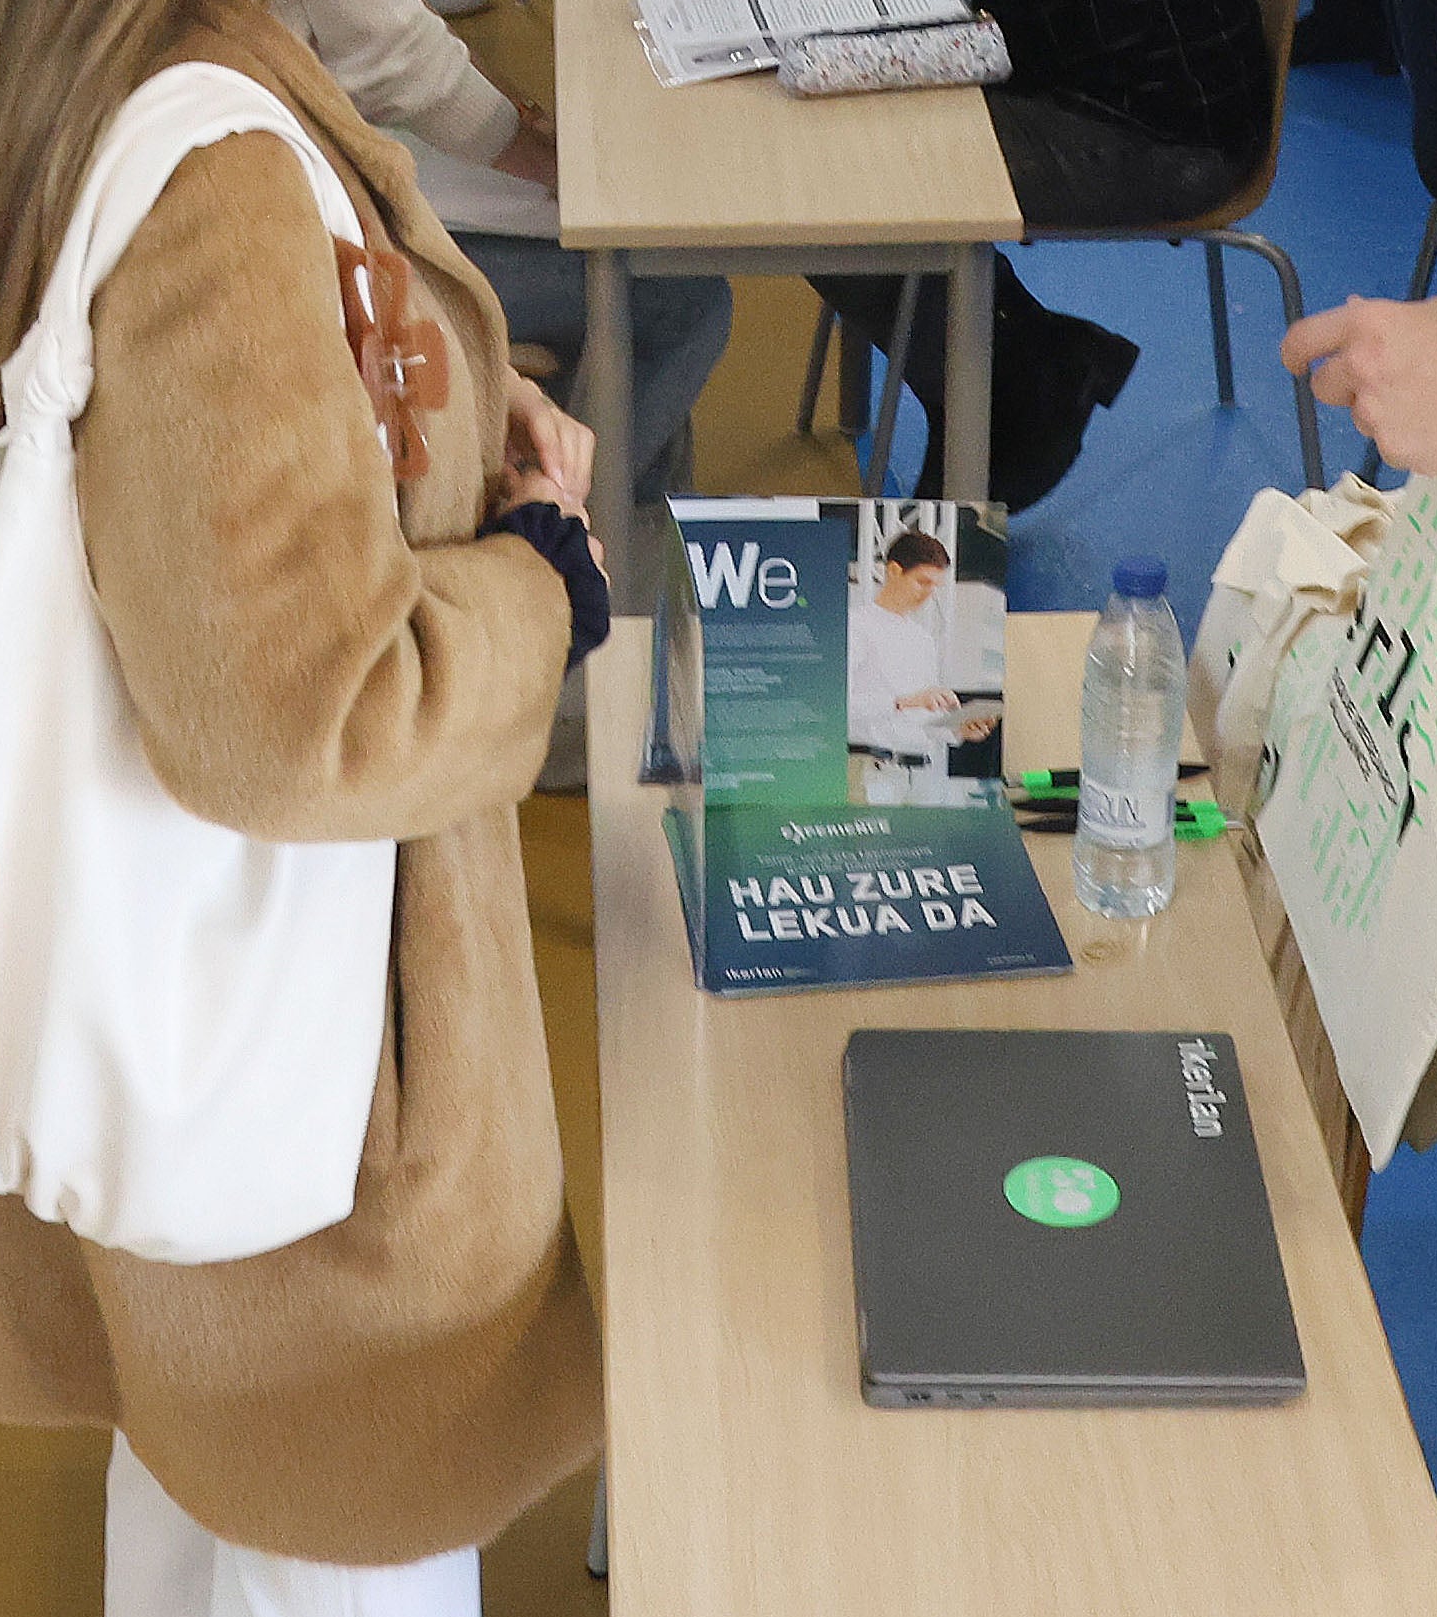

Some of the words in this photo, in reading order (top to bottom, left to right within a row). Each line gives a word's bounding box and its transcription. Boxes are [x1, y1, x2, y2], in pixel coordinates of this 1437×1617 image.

[727, 873, 835, 909] HAU
[846, 863, 984, 902] ZURE
[735, 905, 912, 943] LEKUA
[920, 897, 997, 932] DA
